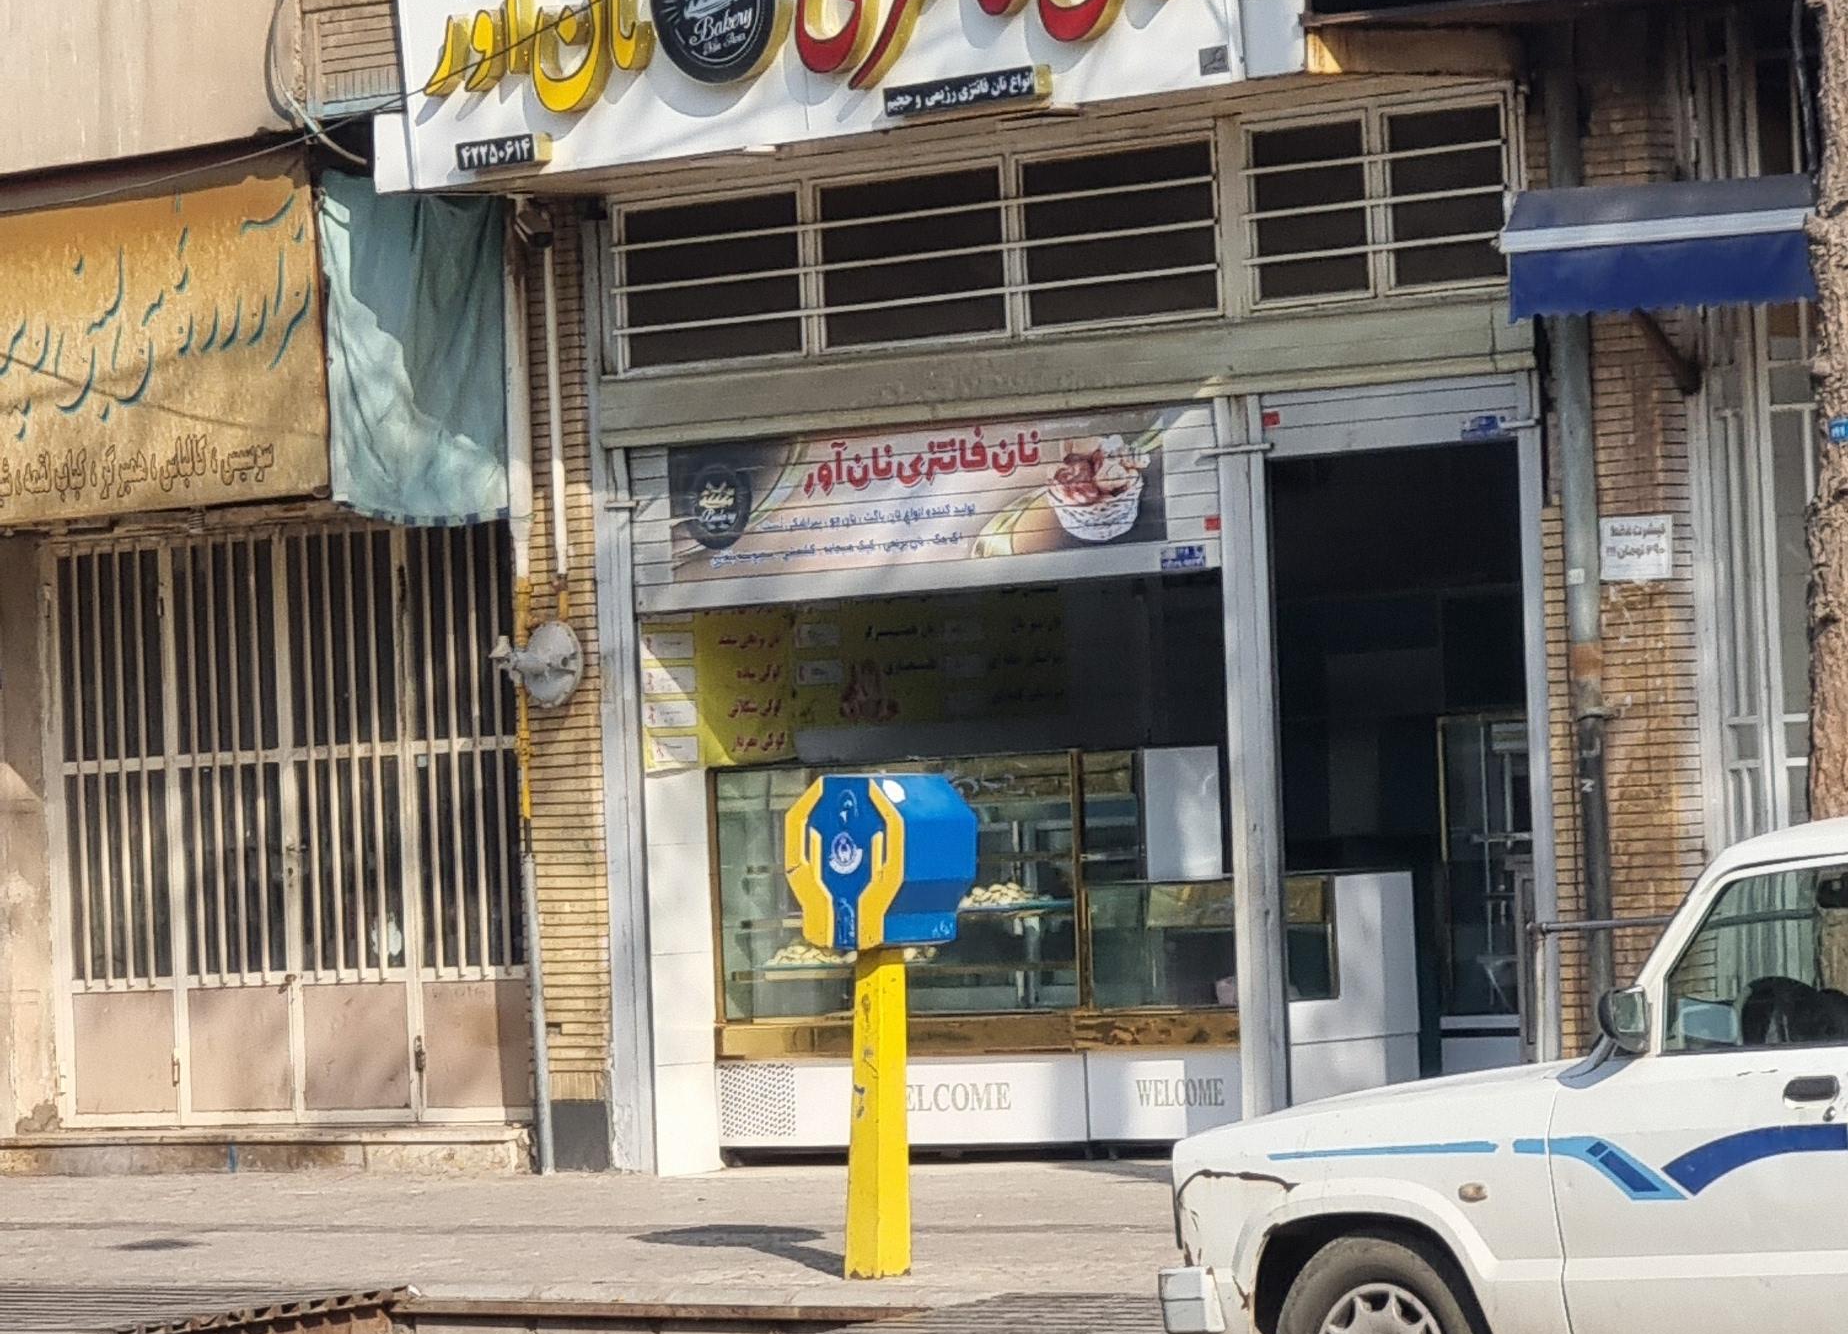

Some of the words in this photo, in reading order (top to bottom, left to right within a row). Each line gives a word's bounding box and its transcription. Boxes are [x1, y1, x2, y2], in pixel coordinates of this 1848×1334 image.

[689, 7, 753, 46] Bakery
[957, 77, 990, 102] فانتزی
[991, 75, 1008, 97] نان
[1008, 71, 1034, 94] انواع
[887, 93, 914, 113] حجیم
[914, 94, 922, 109] و
[461, 137, 531, 168] ۴۲۲۵۰۶۱۴
[846, 443, 894, 491] نان
[896, 425, 989, 488] فانتزی
[991, 429, 1041, 477] نان
[802, 440, 848, 498] آور
[905, 1082, 1012, 1112] ELCOME
[1135, 1077, 1225, 1108] WELCOME
